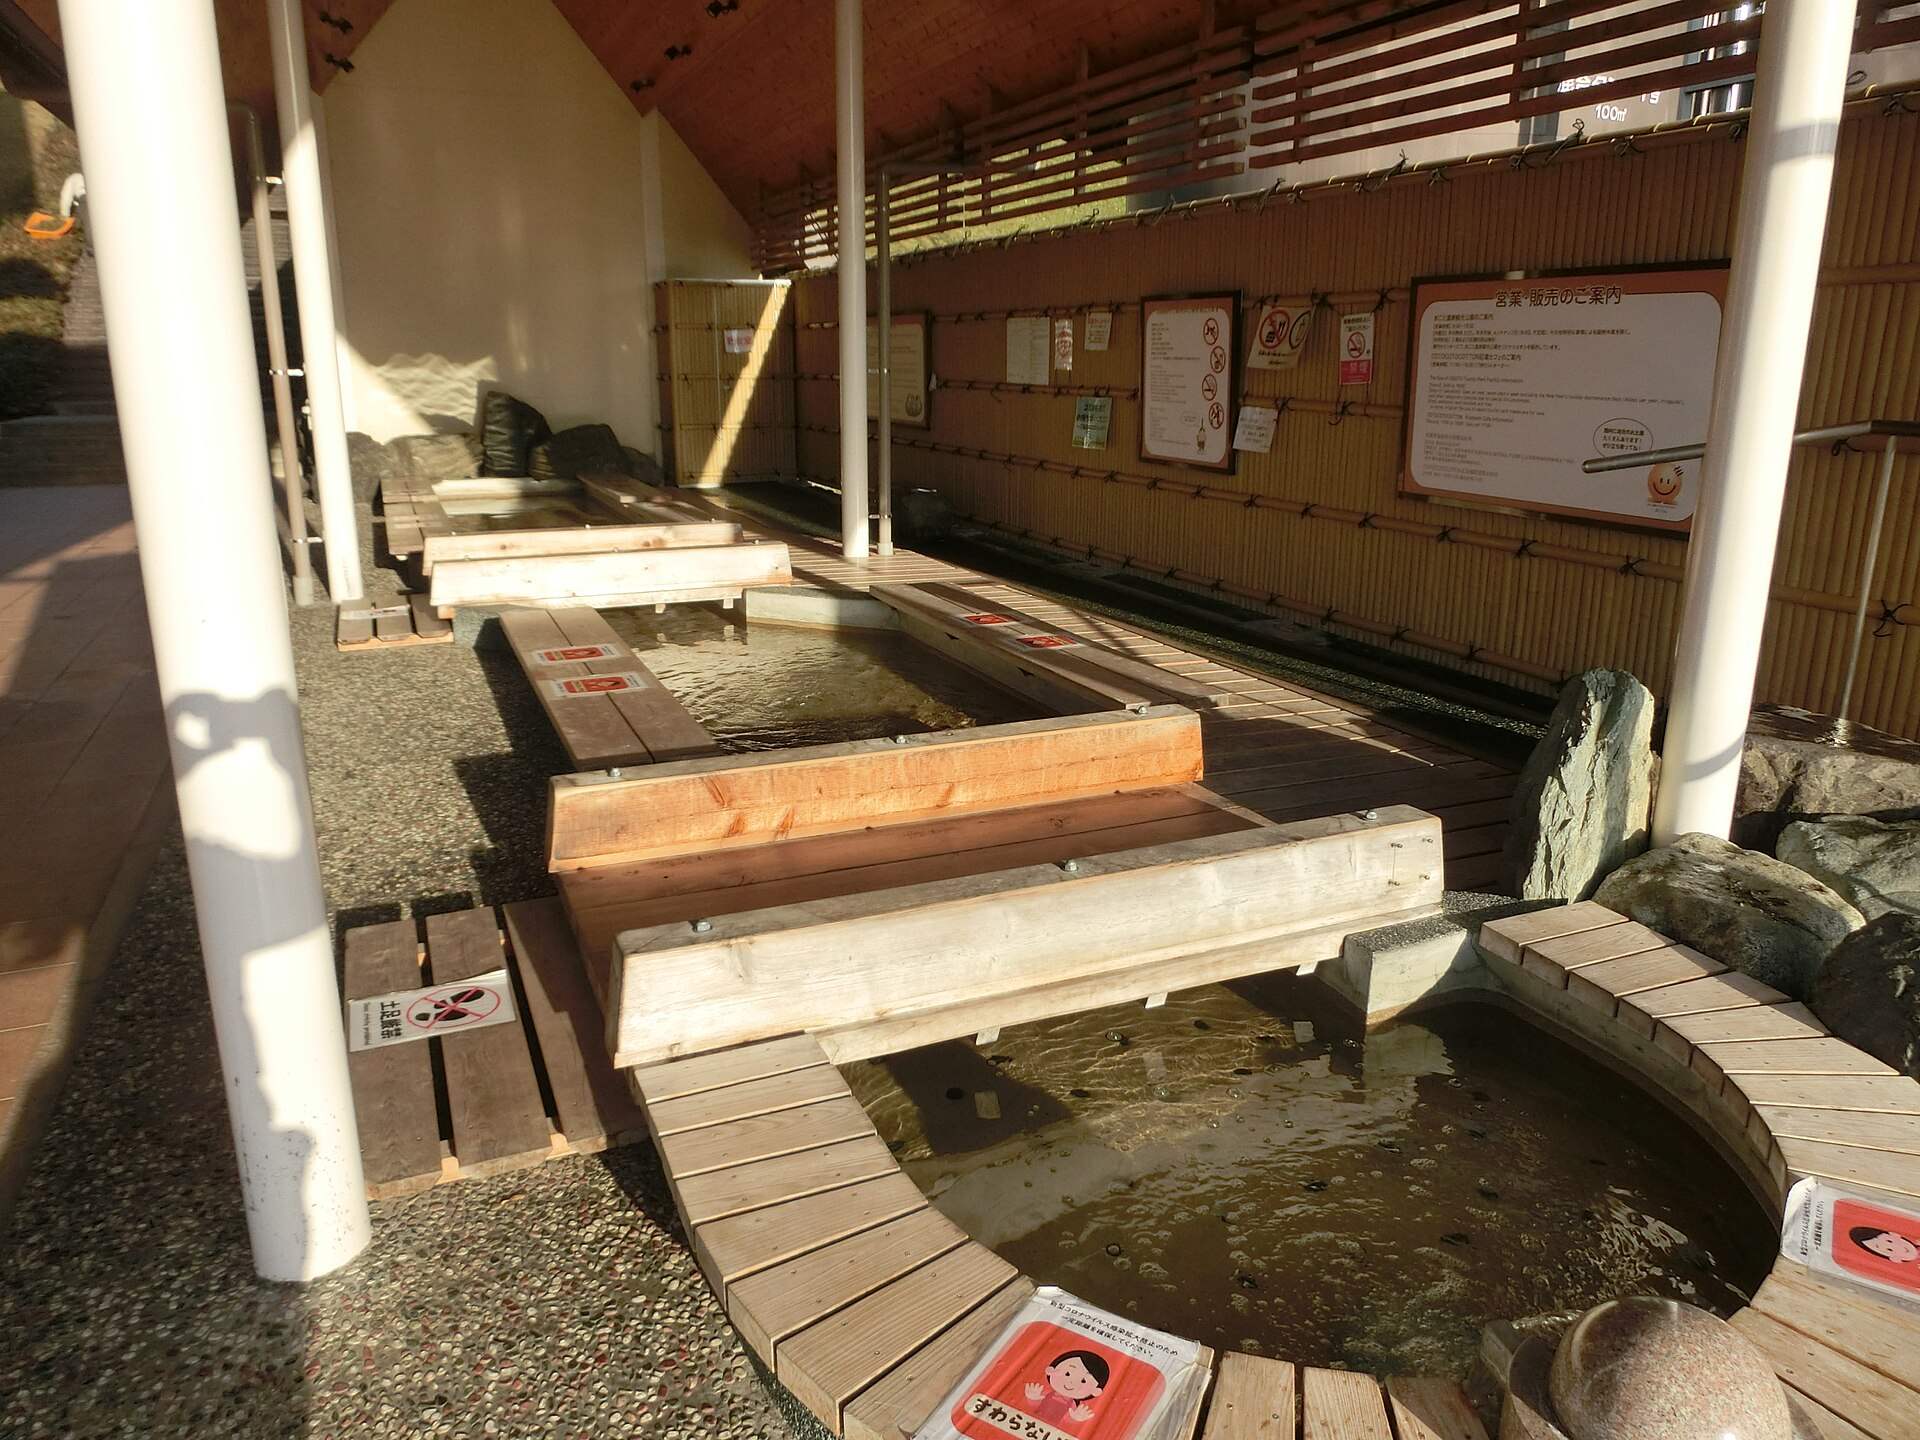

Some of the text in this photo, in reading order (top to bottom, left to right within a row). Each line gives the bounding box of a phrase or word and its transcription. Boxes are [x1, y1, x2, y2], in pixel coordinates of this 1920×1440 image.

[1495, 285, 1623, 308] 営業・販売のご案内
